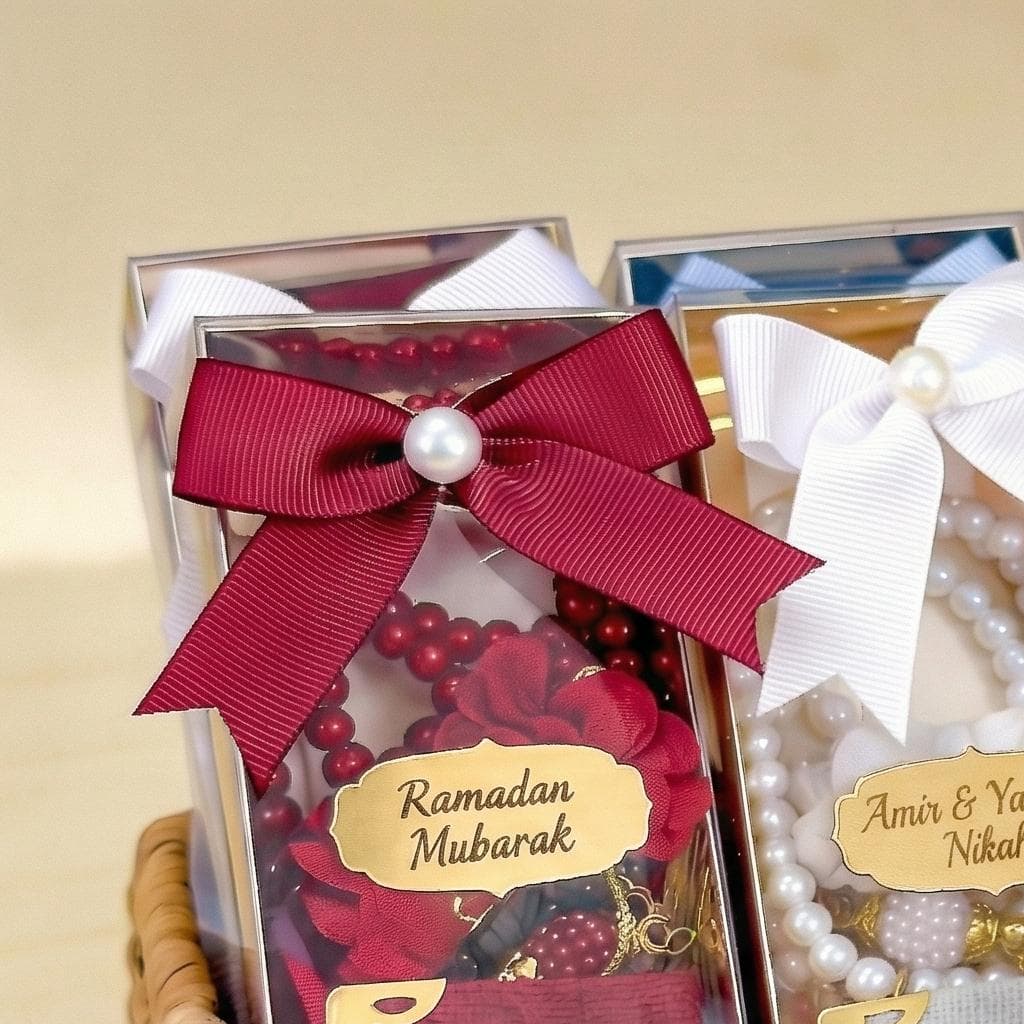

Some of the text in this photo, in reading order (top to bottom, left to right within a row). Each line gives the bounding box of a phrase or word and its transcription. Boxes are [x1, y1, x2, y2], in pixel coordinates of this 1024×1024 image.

[398, 768, 575, 820] Ramadan
[861, 791, 943, 834] Amir
[952, 784, 977, 821] &
[410, 812, 576, 871] Mubarak
